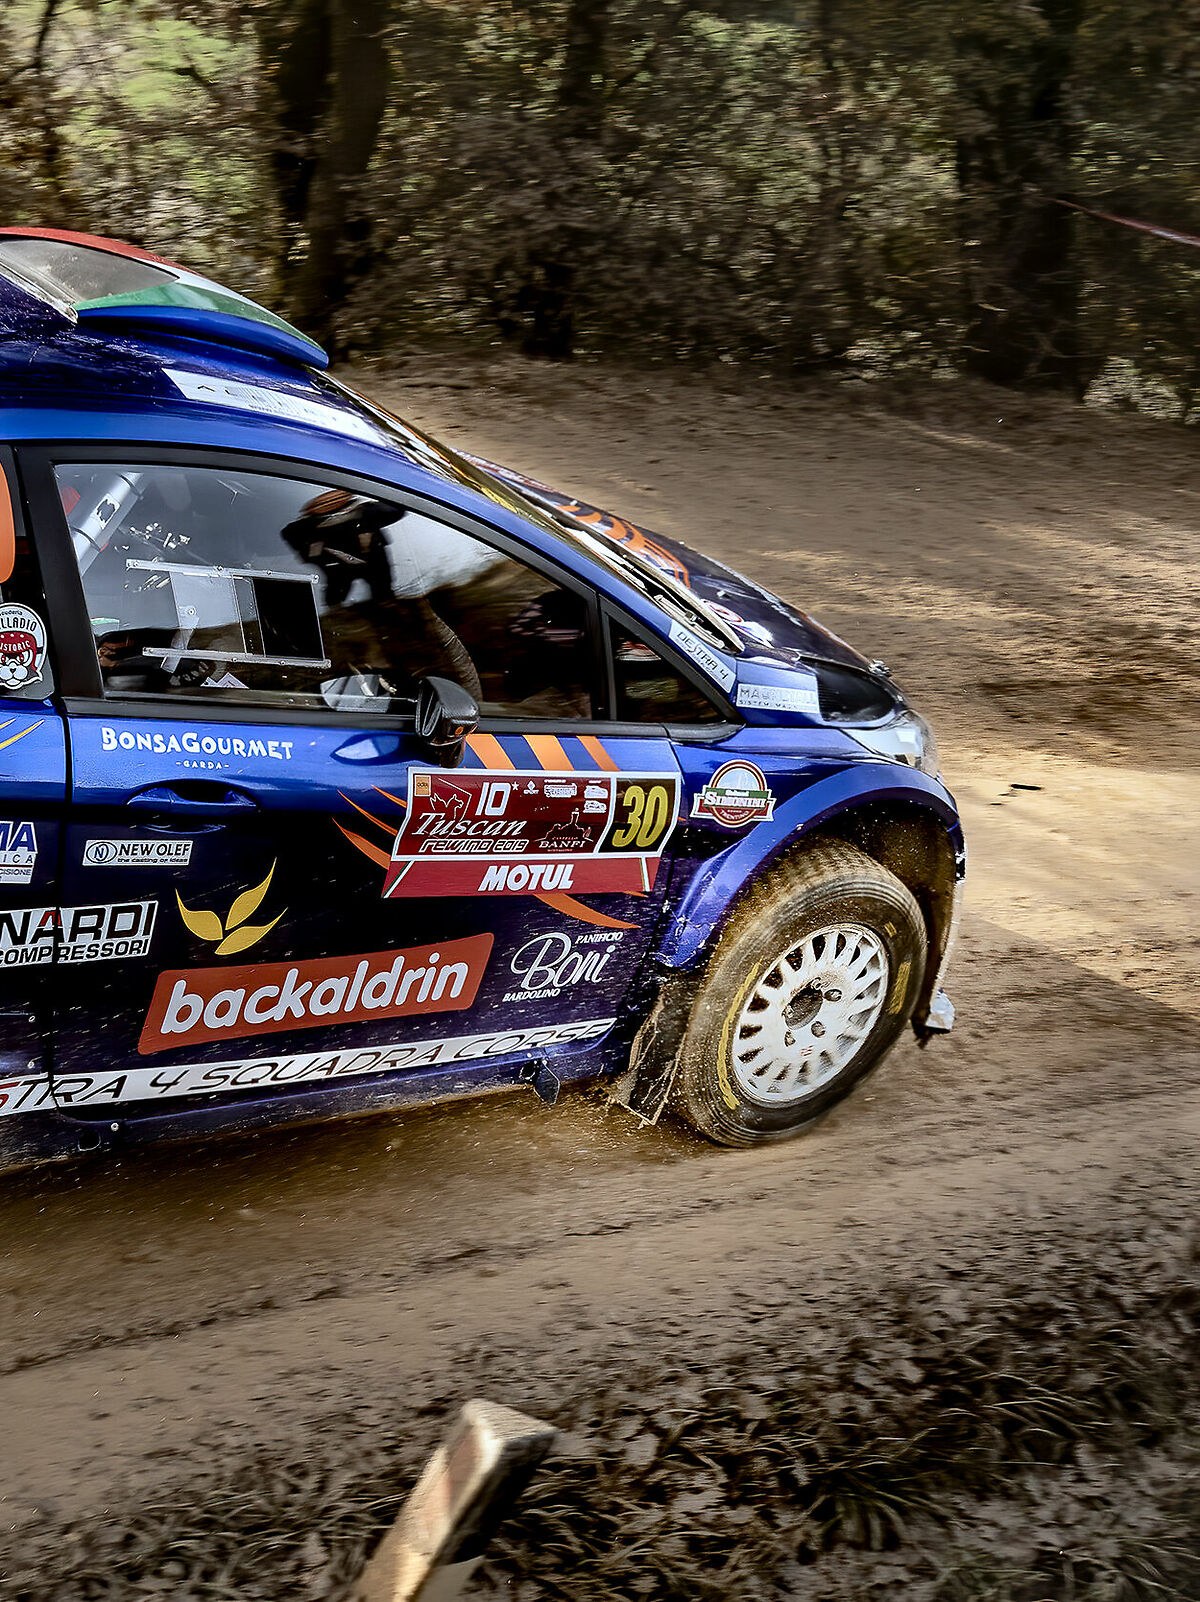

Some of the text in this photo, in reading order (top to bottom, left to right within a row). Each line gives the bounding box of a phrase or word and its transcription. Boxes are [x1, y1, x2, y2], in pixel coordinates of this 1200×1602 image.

[475, 782, 511, 816] 10
[411, 812, 528, 836] Tuscan
[612, 785, 669, 848] 30
[119, 843, 191, 856] NEW OLEF
[539, 840, 586, 849] BANFI
[478, 864, 575, 892] MOTUL
[575, 931, 624, 945] PANIFICIO
[510, 932, 616, 991] Boni
[159, 952, 470, 1035] backaldrin
[502, 988, 561, 1002] BARDOLINO
[150, 1069, 191, 1094] 4
[188, 1043, 446, 1090] SQUADRA
[455, 1022, 612, 1060] CORSE
